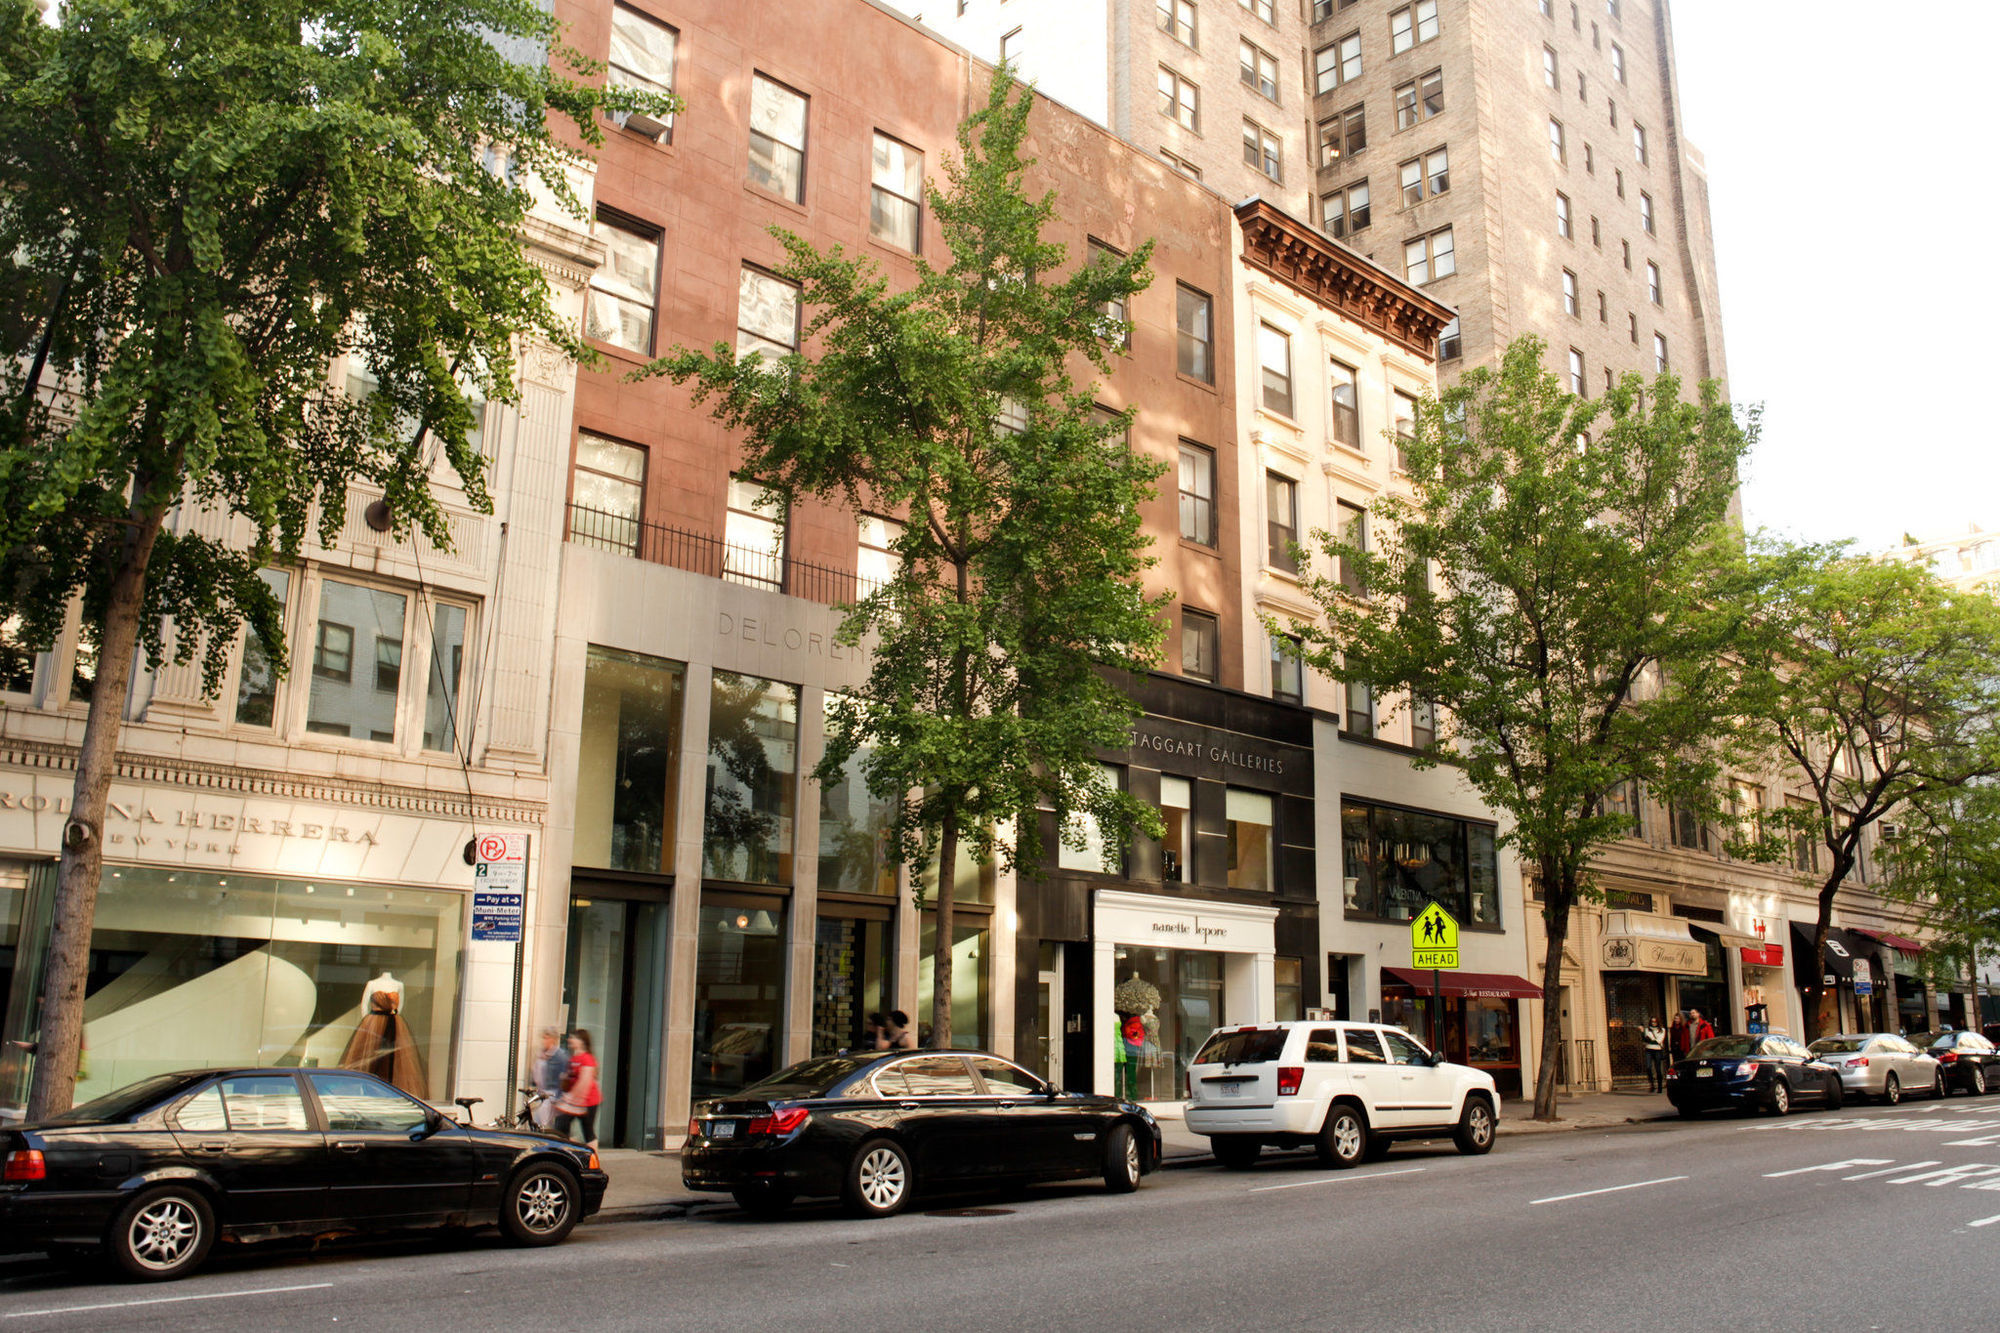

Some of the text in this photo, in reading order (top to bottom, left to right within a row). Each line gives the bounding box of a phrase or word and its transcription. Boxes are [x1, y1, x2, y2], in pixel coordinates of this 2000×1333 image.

[1131, 731, 1283, 774] TAGGART GALLERIES
[0, 790, 379, 846] ROLNA HERRERA
[110, 833, 241, 855] EW YORK
[478, 864, 486, 876] 2
[486, 895, 510, 905] Pay at
[475, 906, 519, 914] Muni-Meter
[1152, 915, 1228, 945] nanette lepore
[1417, 953, 1454, 965] AHEAD
